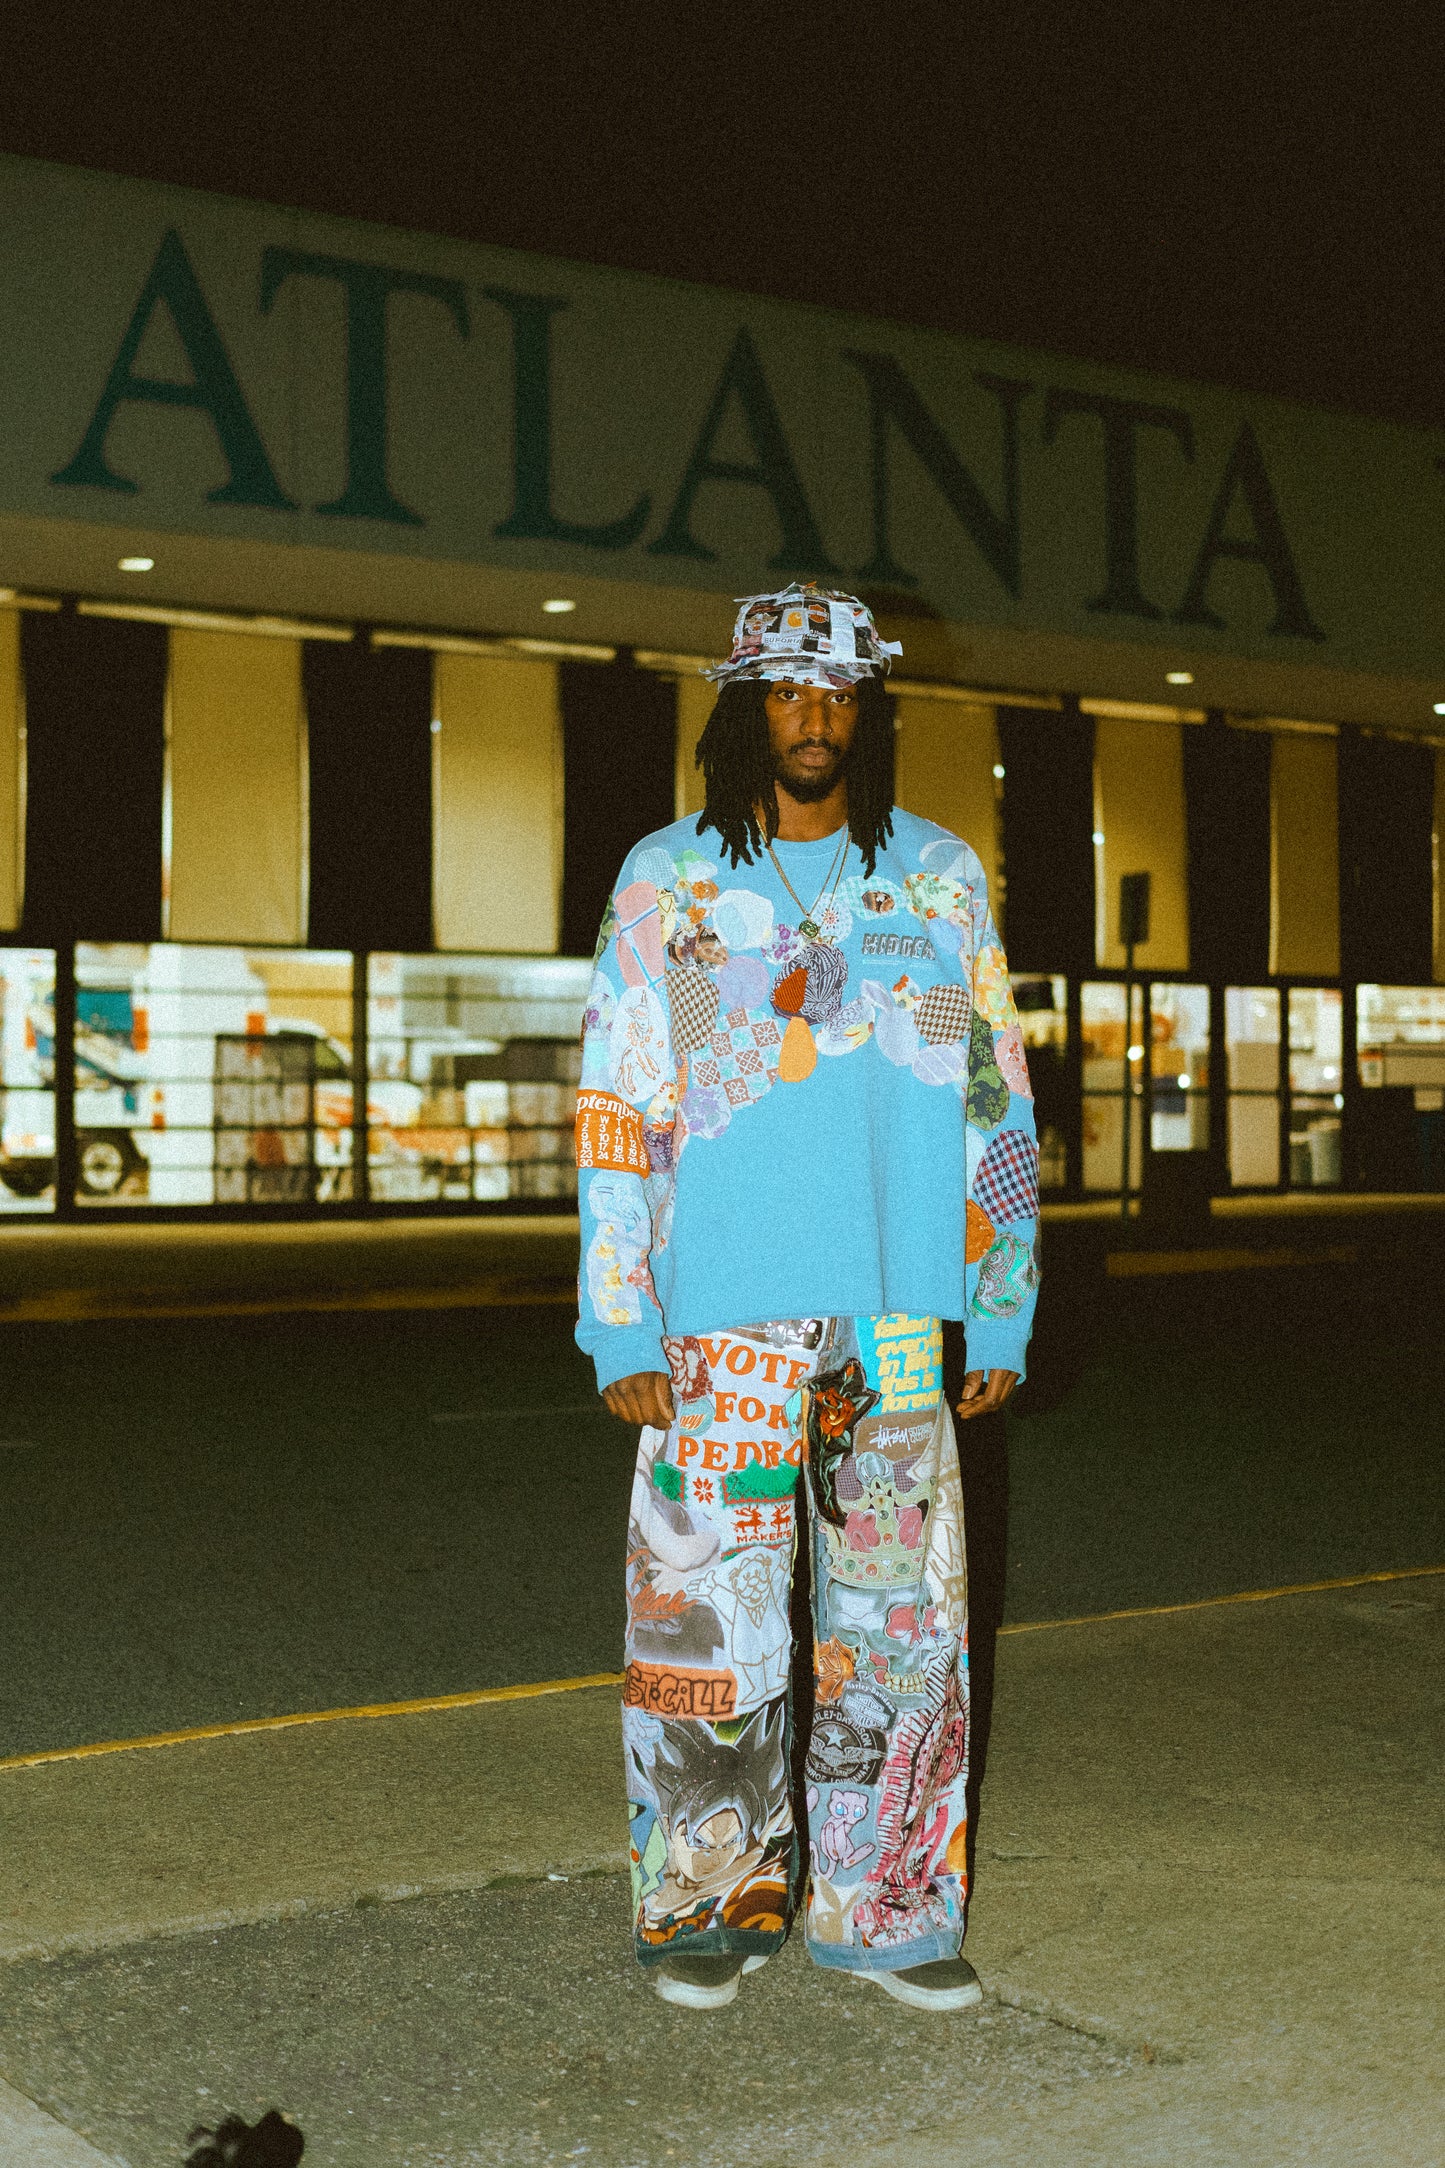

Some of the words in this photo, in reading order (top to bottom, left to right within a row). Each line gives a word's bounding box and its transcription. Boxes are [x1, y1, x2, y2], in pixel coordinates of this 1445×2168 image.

[50, 224, 1327, 645] ATLANTA
[581, 1140, 591, 1150] 16
[599, 1133, 609, 1143] 10
[580, 1149, 593, 1159] 23
[597, 1150, 609, 1160] 24
[612, 1153, 625, 1163] 25
[580, 1158, 594, 1168] 30
[698, 1337, 811, 1390] VOTE
[736, 1528, 792, 1544] MAKER'S
